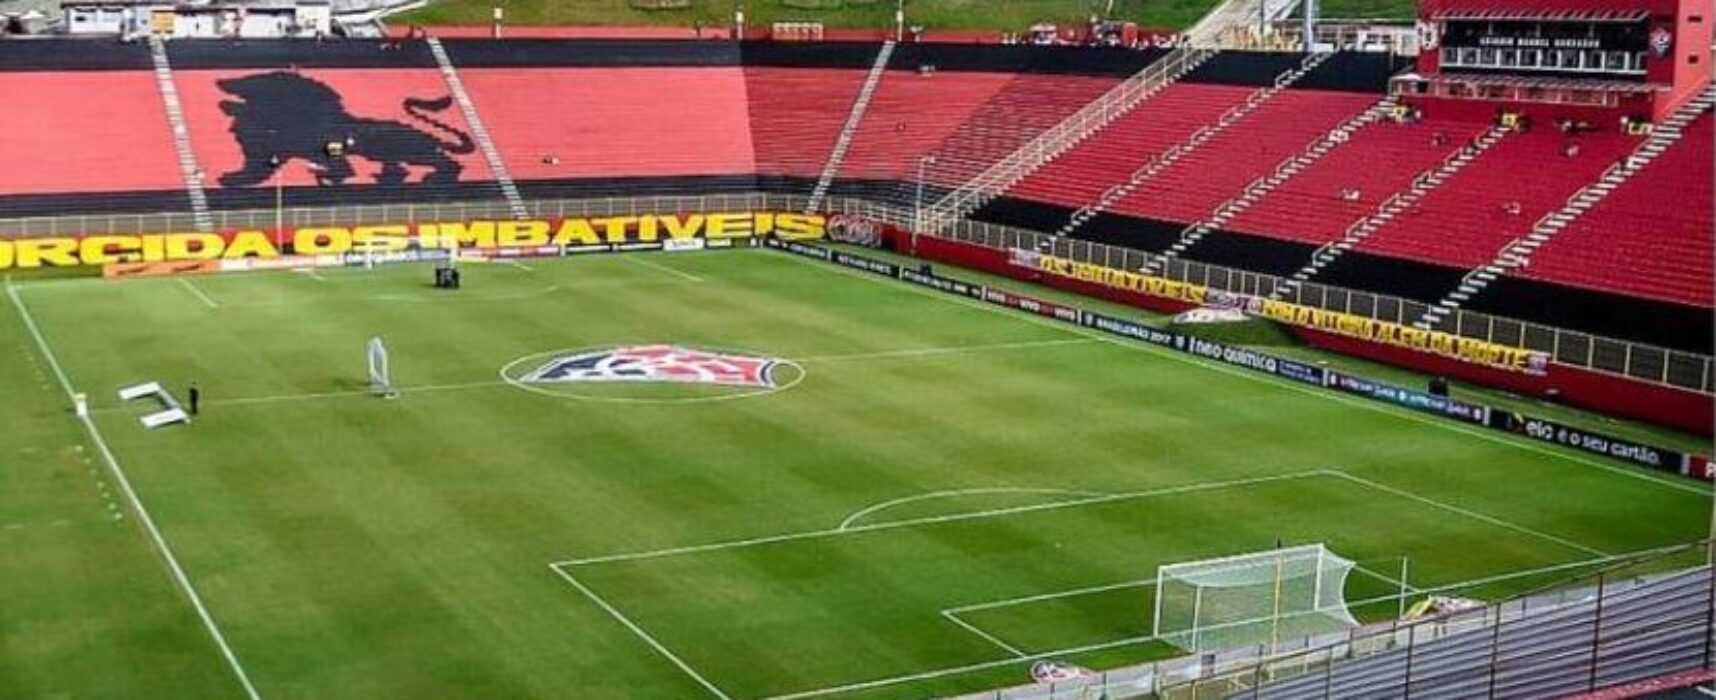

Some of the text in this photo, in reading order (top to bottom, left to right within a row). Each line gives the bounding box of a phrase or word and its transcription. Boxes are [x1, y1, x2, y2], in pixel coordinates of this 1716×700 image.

[0, 231, 279, 268] RCIDA
[293, 225, 408, 255] OS
[1195, 341, 1222, 358] neo
[1525, 420, 1554, 440] elo
[1569, 434, 1580, 446] o
[1582, 436, 1608, 453] seu
